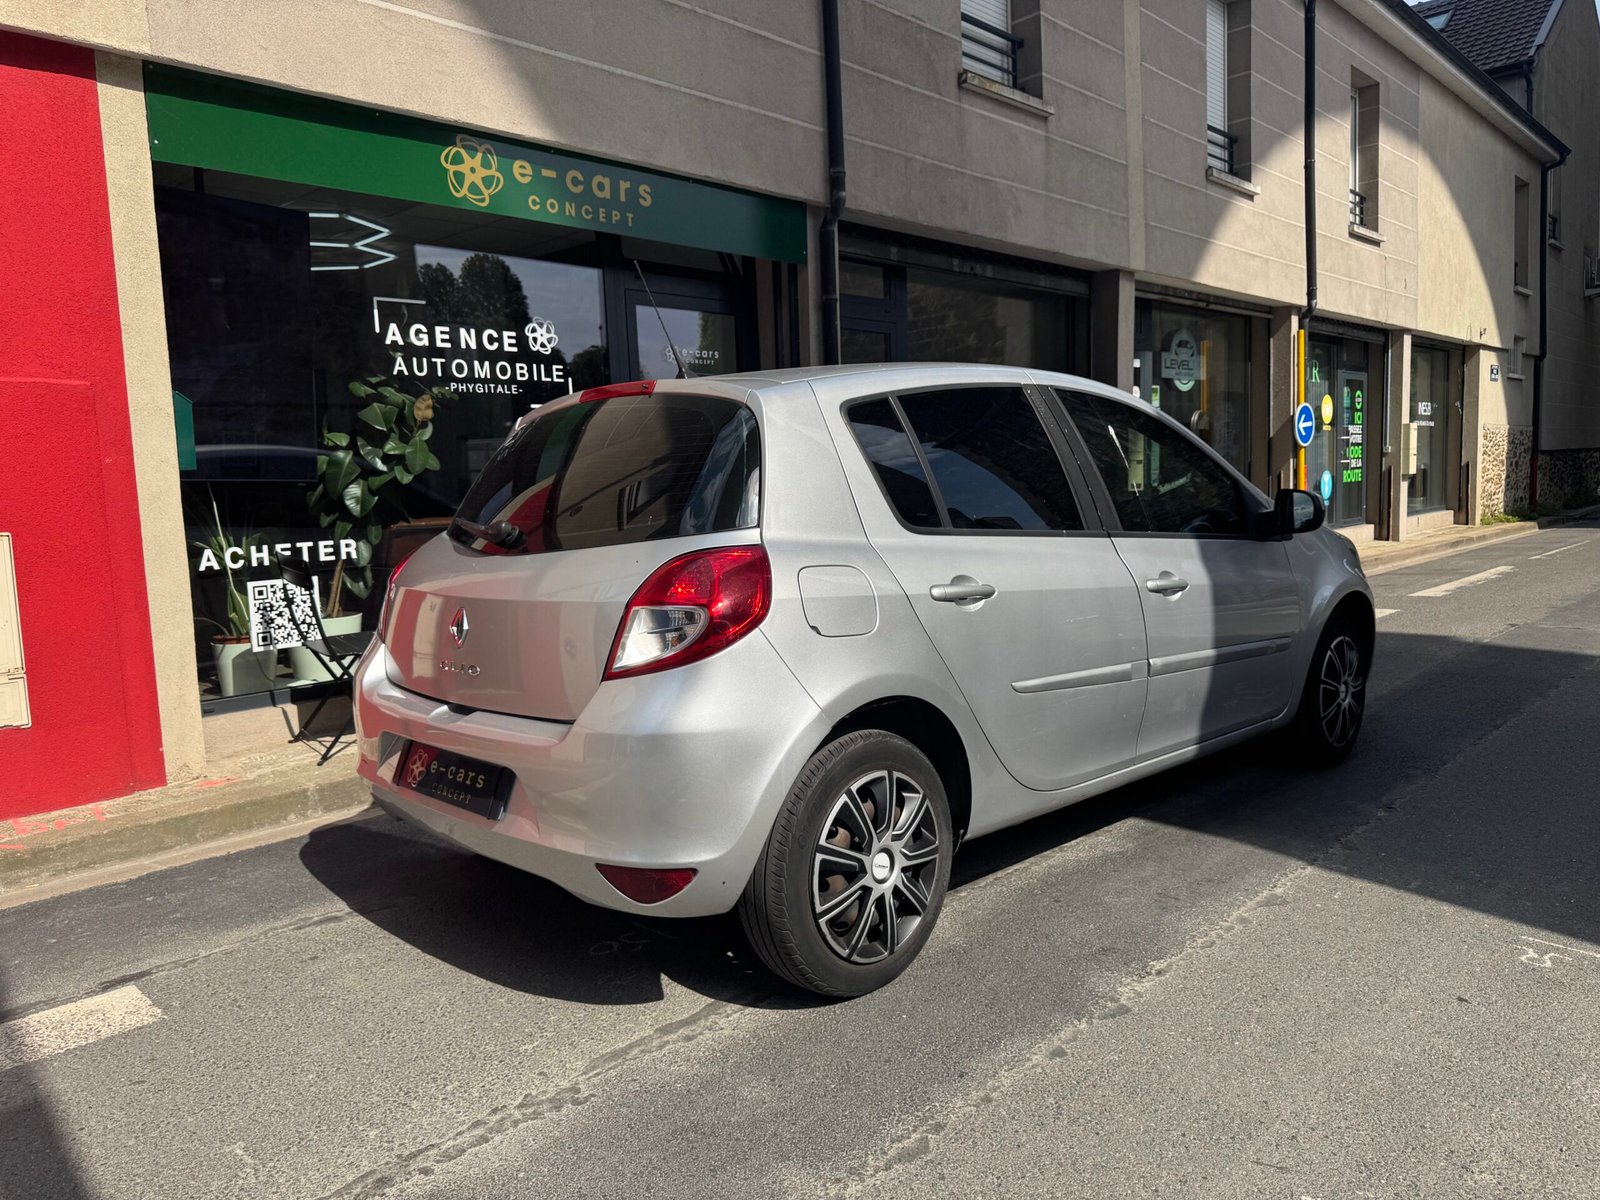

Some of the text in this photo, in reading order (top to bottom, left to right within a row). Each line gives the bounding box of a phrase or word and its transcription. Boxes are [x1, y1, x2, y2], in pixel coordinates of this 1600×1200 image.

[512, 159, 653, 207] e-cars
[528, 195, 634, 227] CONCEPT
[385, 322, 518, 352] AGENCE
[681, 348, 720, 359] e-cars
[1164, 358, 1193, 371] LEVEL
[393, 356, 565, 382] AUTOMOBILE
[445, 382, 523, 395] -PHYGITALE-
[1343, 469, 1362, 483] ROUTE
[430, 760, 486, 789] e-cars
